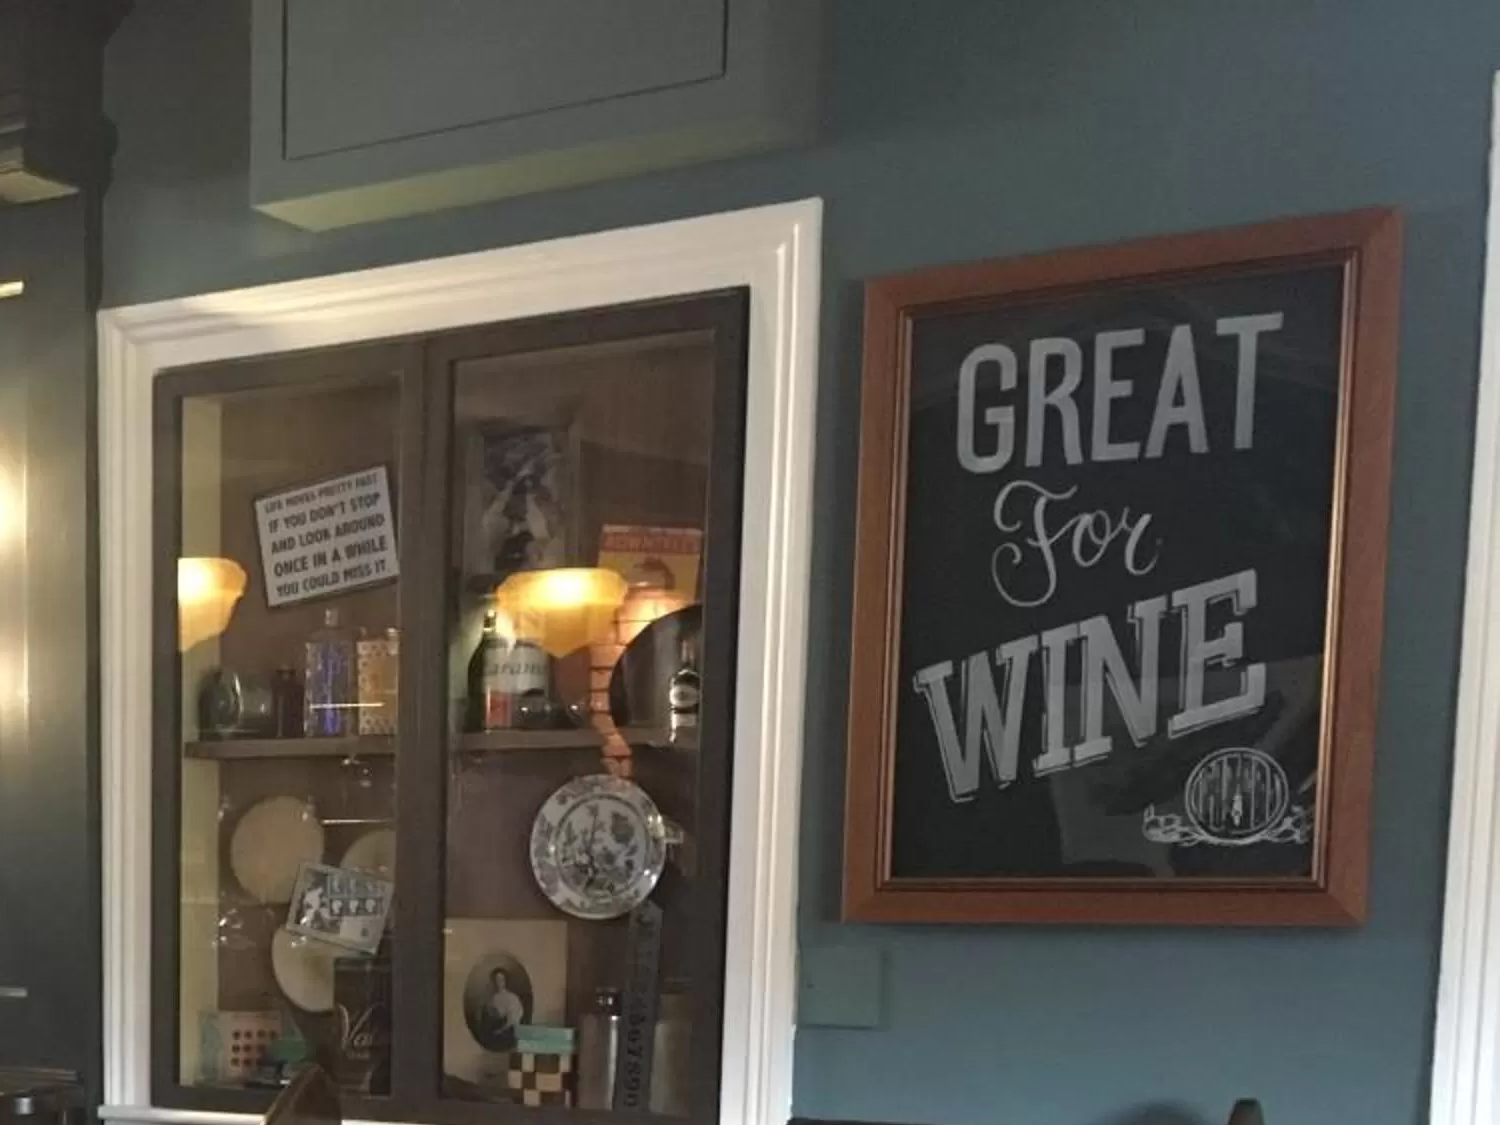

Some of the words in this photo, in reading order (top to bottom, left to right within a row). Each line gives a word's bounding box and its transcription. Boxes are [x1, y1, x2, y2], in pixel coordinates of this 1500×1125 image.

[957, 311, 1283, 473] GREAT
[268, 518, 278, 534] IF
[284, 512, 307, 528] YOU
[310, 501, 346, 522] DON'T
[350, 492, 381, 512] STOP
[271, 536, 296, 554] AND
[299, 528, 332, 547] LOOK
[335, 513, 386, 537] AROUND
[274, 555, 309, 577] ONCE
[312, 551, 327, 568] IN
[331, 547, 341, 562] A
[344, 535, 389, 560] WHILE
[991, 479, 1158, 607] For
[276, 582, 299, 597] YOU
[301, 571, 340, 592] COULD
[343, 563, 372, 582] MISS
[375, 559, 386, 574] IT
[913, 568, 1266, 803] WINE
